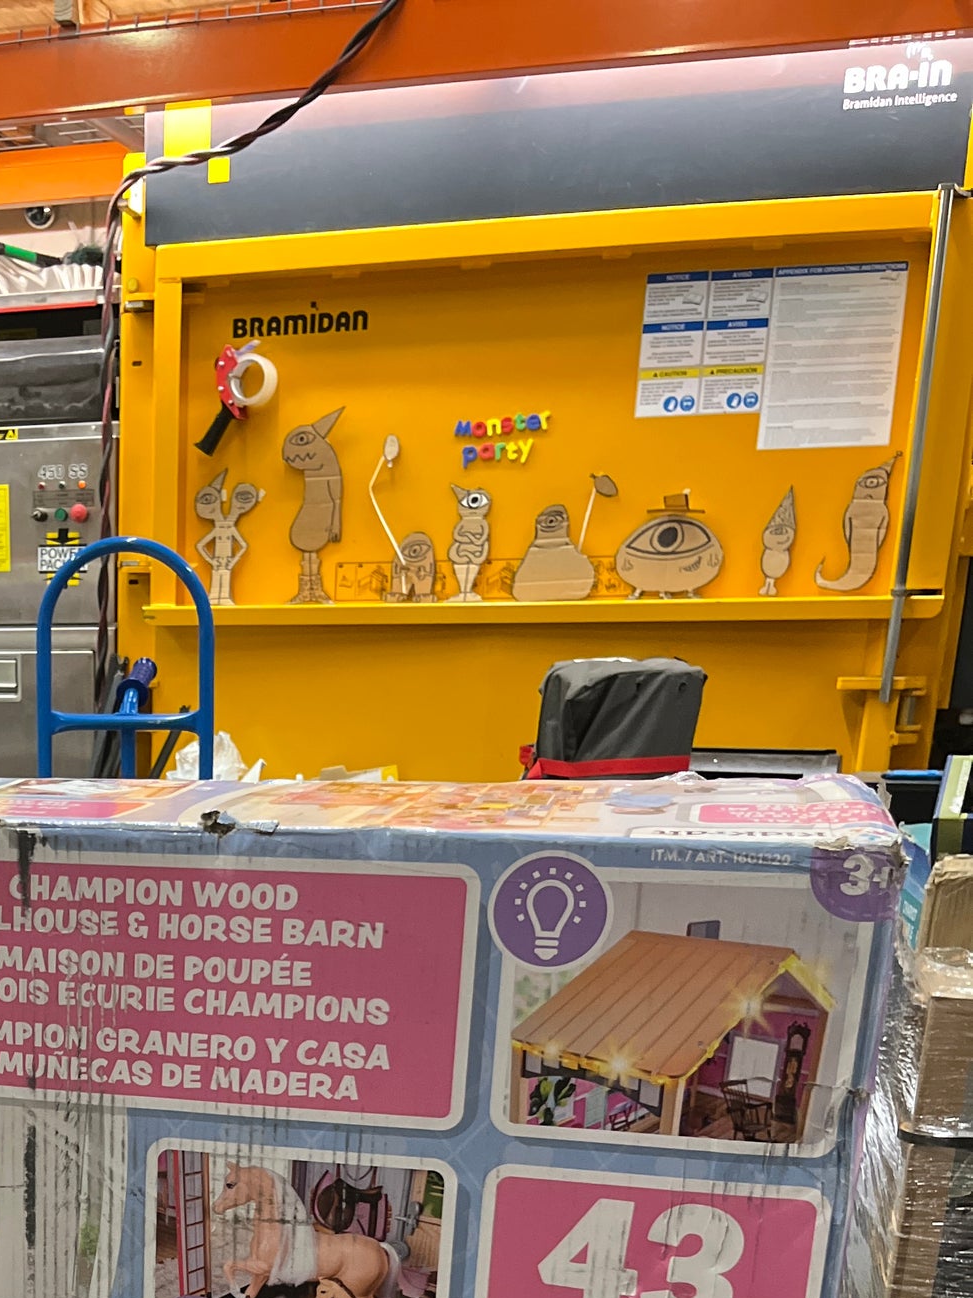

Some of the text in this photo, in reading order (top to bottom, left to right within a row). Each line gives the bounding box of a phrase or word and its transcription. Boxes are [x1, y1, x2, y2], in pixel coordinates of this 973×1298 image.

[842, 92, 958, 110] Bramidan Intelligence
[68, 463, 88, 479] SS
[650, 848, 681, 862] ITM.
[694, 849, 727, 864] ART.
[8, 872, 300, 912] CHAMPION WOOD
[127, 914, 149, 939] &
[157, 912, 273, 946] HORSE
[282, 918, 385, 950] BARN
[134, 952, 173, 980] DE
[183, 952, 313, 988] POUPÉE
[57, 974, 177, 1013] ÉCURIE
[183, 988, 391, 1026] CHAMPIONS
[96, 1025, 257, 1063] GRANERO
[266, 1038, 290, 1065] Y
[295, 1039, 391, 1071] CASA
[161, 1062, 203, 1091] DE
[210, 1066, 359, 1102] MADERA
